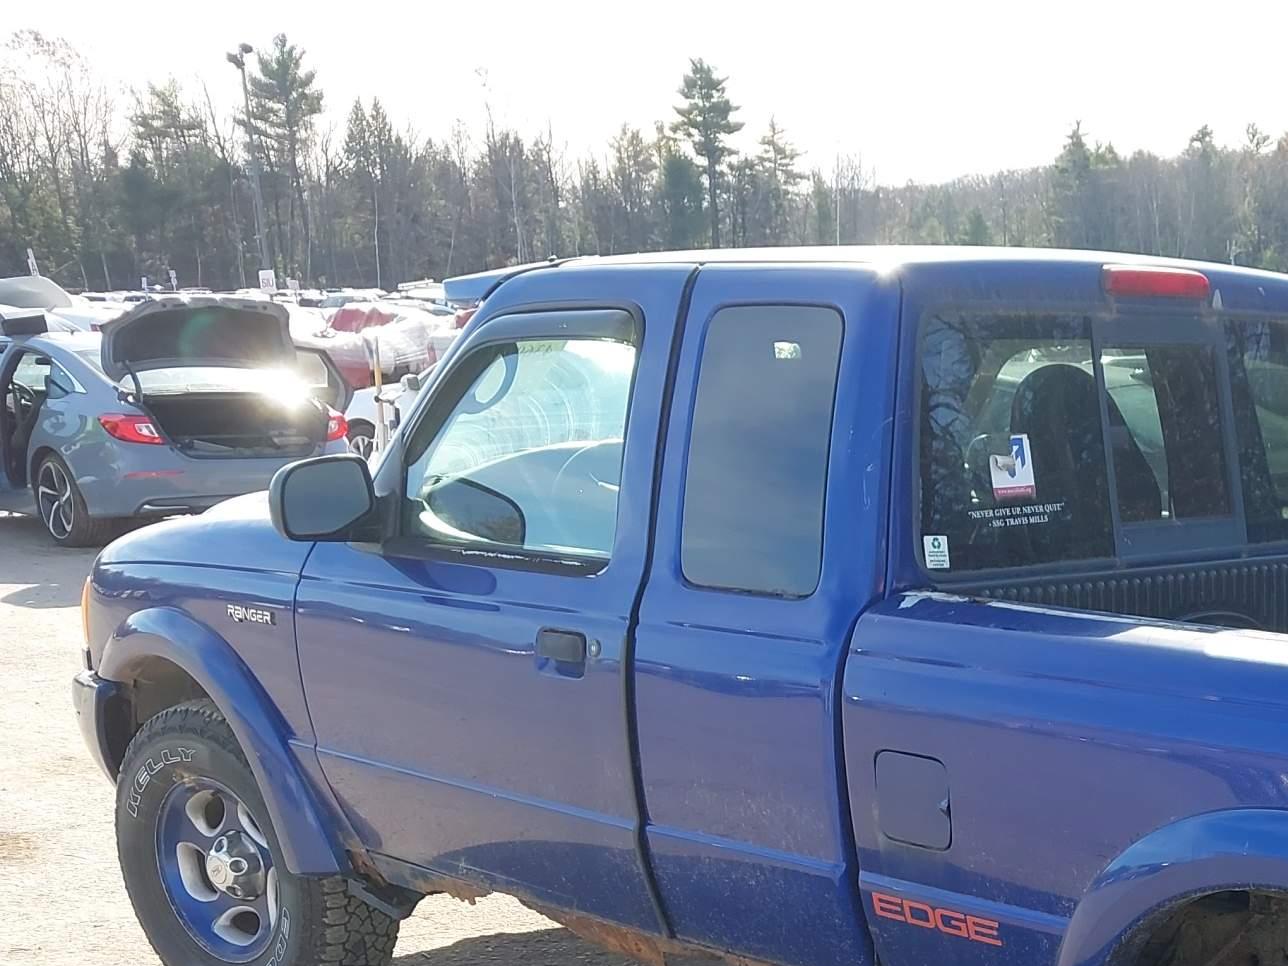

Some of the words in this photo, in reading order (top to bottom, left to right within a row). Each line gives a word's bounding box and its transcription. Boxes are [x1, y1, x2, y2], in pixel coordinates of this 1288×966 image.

[994, 508, 1011, 517] GIVE
[1022, 504, 1044, 514] NEVER
[1005, 516, 1028, 526] TRAVIS
[1028, 514, 1049, 523] MILLS
[127, 747, 196, 818] KELLY
[871, 891, 1002, 946] EDGE
